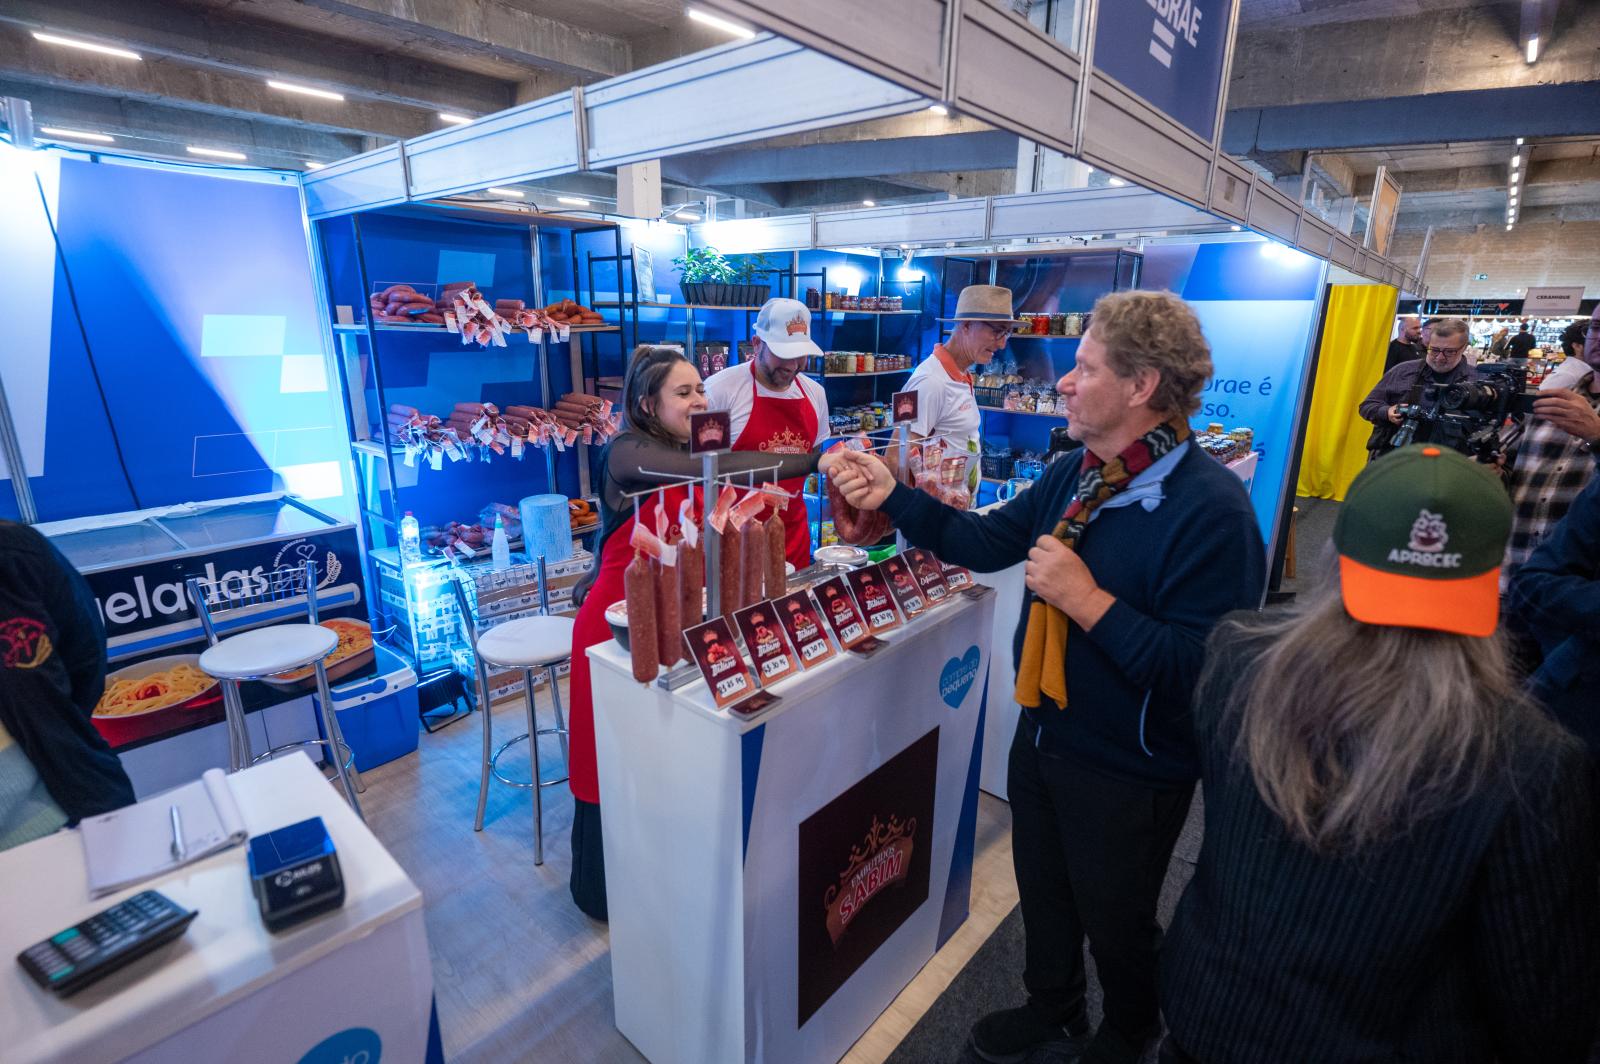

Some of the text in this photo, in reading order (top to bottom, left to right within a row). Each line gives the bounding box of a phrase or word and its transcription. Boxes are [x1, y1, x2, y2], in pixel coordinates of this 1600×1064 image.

[1258, 376, 1272, 396] é
[95, 562, 269, 628] eladas
[840, 849, 903, 924] SABIM
